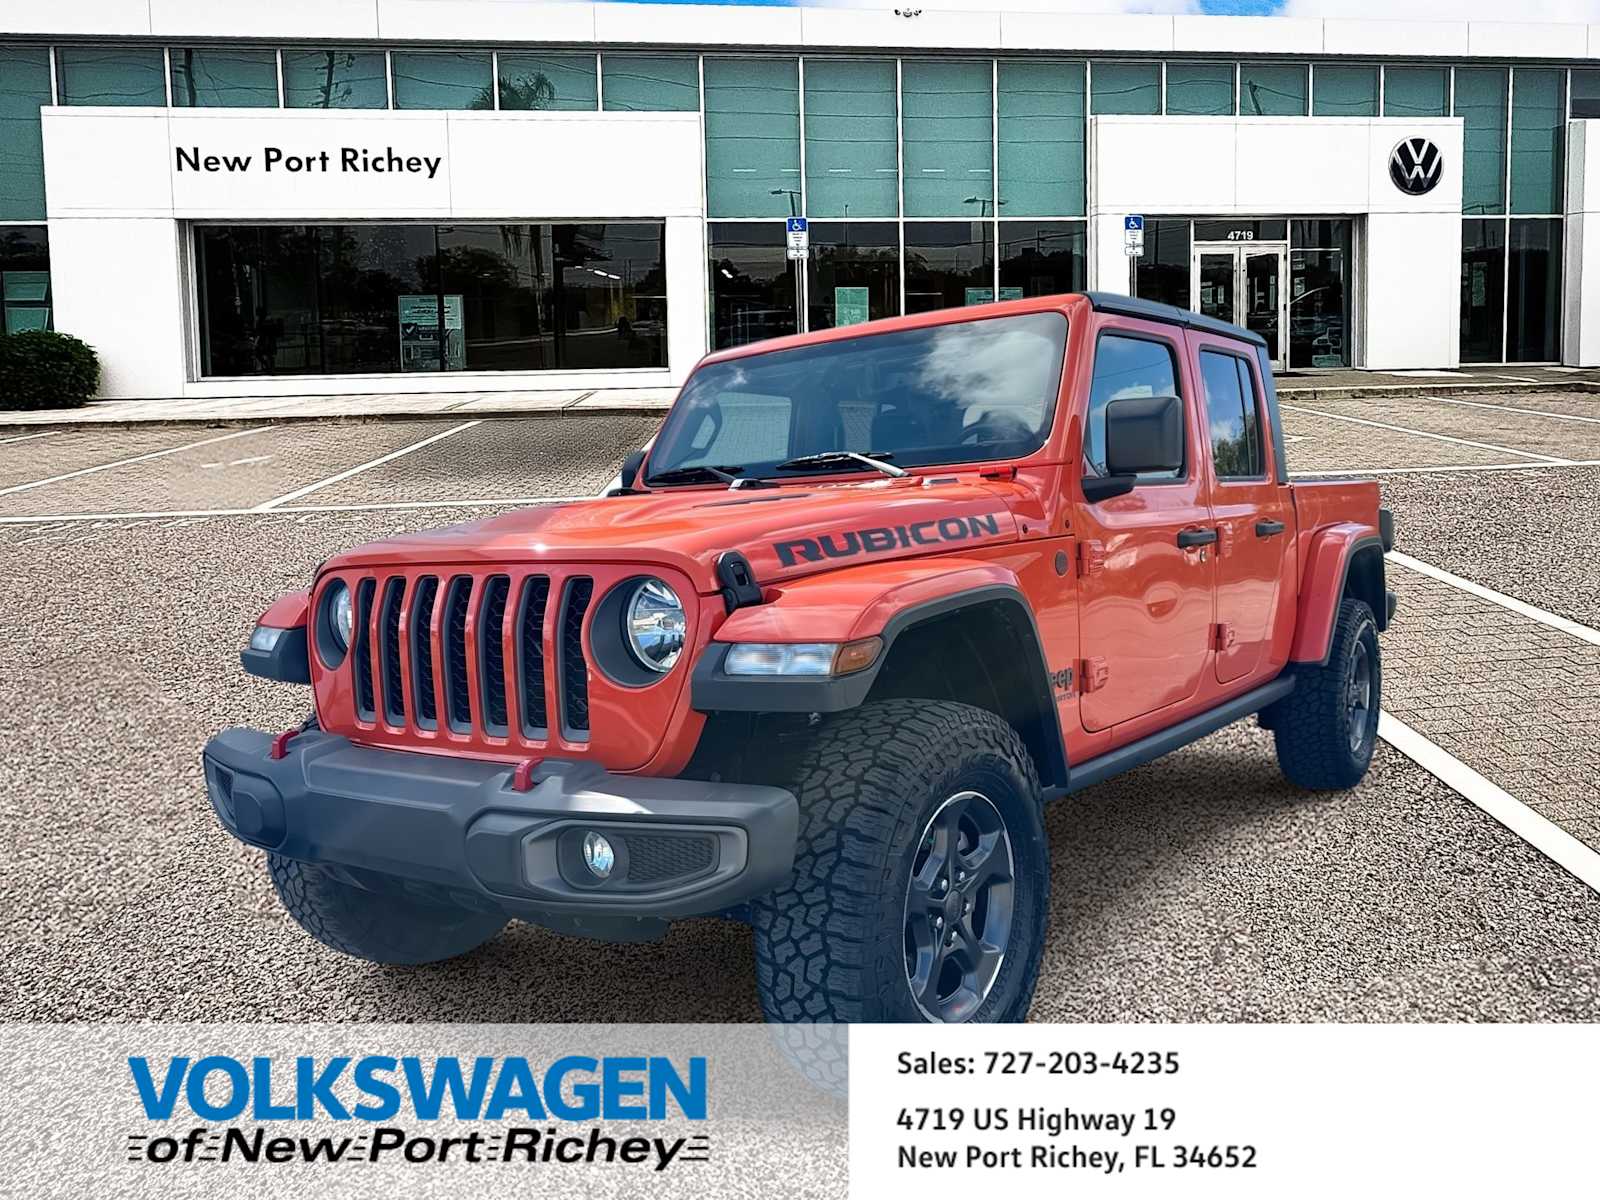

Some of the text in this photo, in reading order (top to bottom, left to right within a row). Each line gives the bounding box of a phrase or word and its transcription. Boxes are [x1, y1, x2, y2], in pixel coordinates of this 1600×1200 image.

[175, 147, 442, 179] New Port Richey
[1227, 230, 1254, 240] 4719
[773, 513, 999, 568] RUBICON
